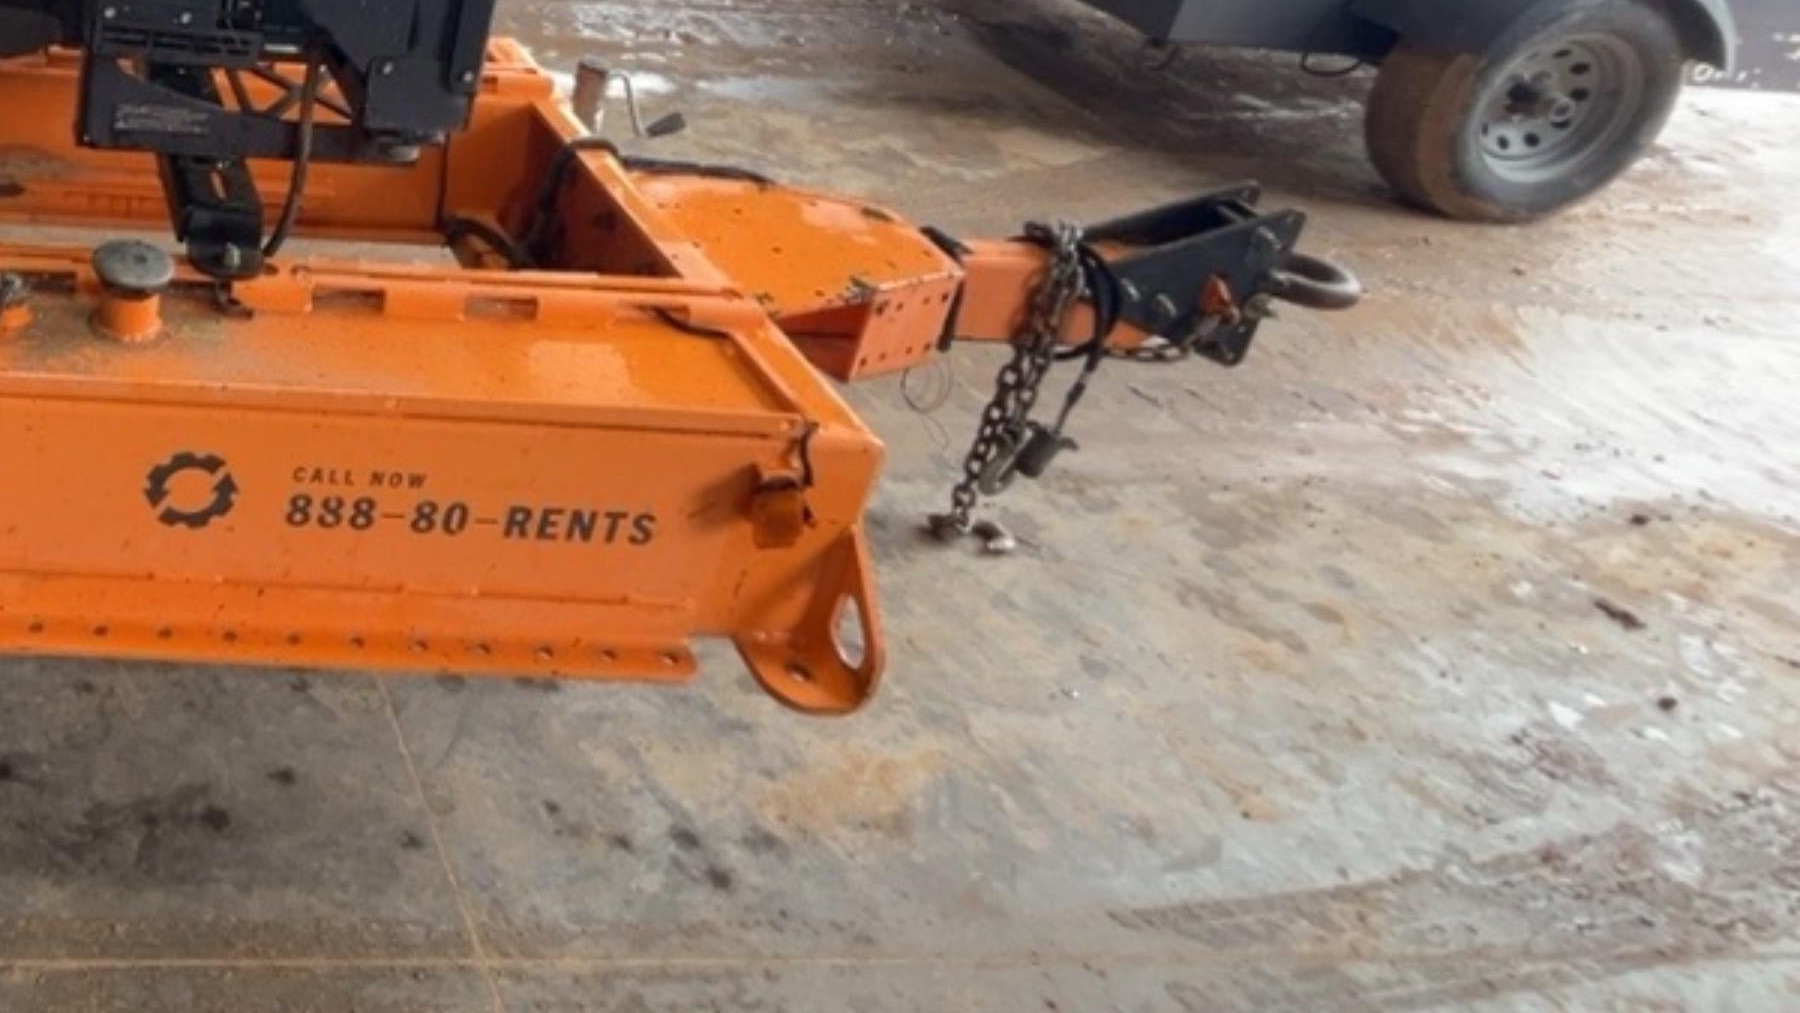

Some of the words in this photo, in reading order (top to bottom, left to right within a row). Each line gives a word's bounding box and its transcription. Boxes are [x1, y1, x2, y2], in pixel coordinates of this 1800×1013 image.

[293, 466, 355, 487] CALL
[369, 471, 428, 490] NOW
[285, 492, 657, 547] 888-80-RENTS
